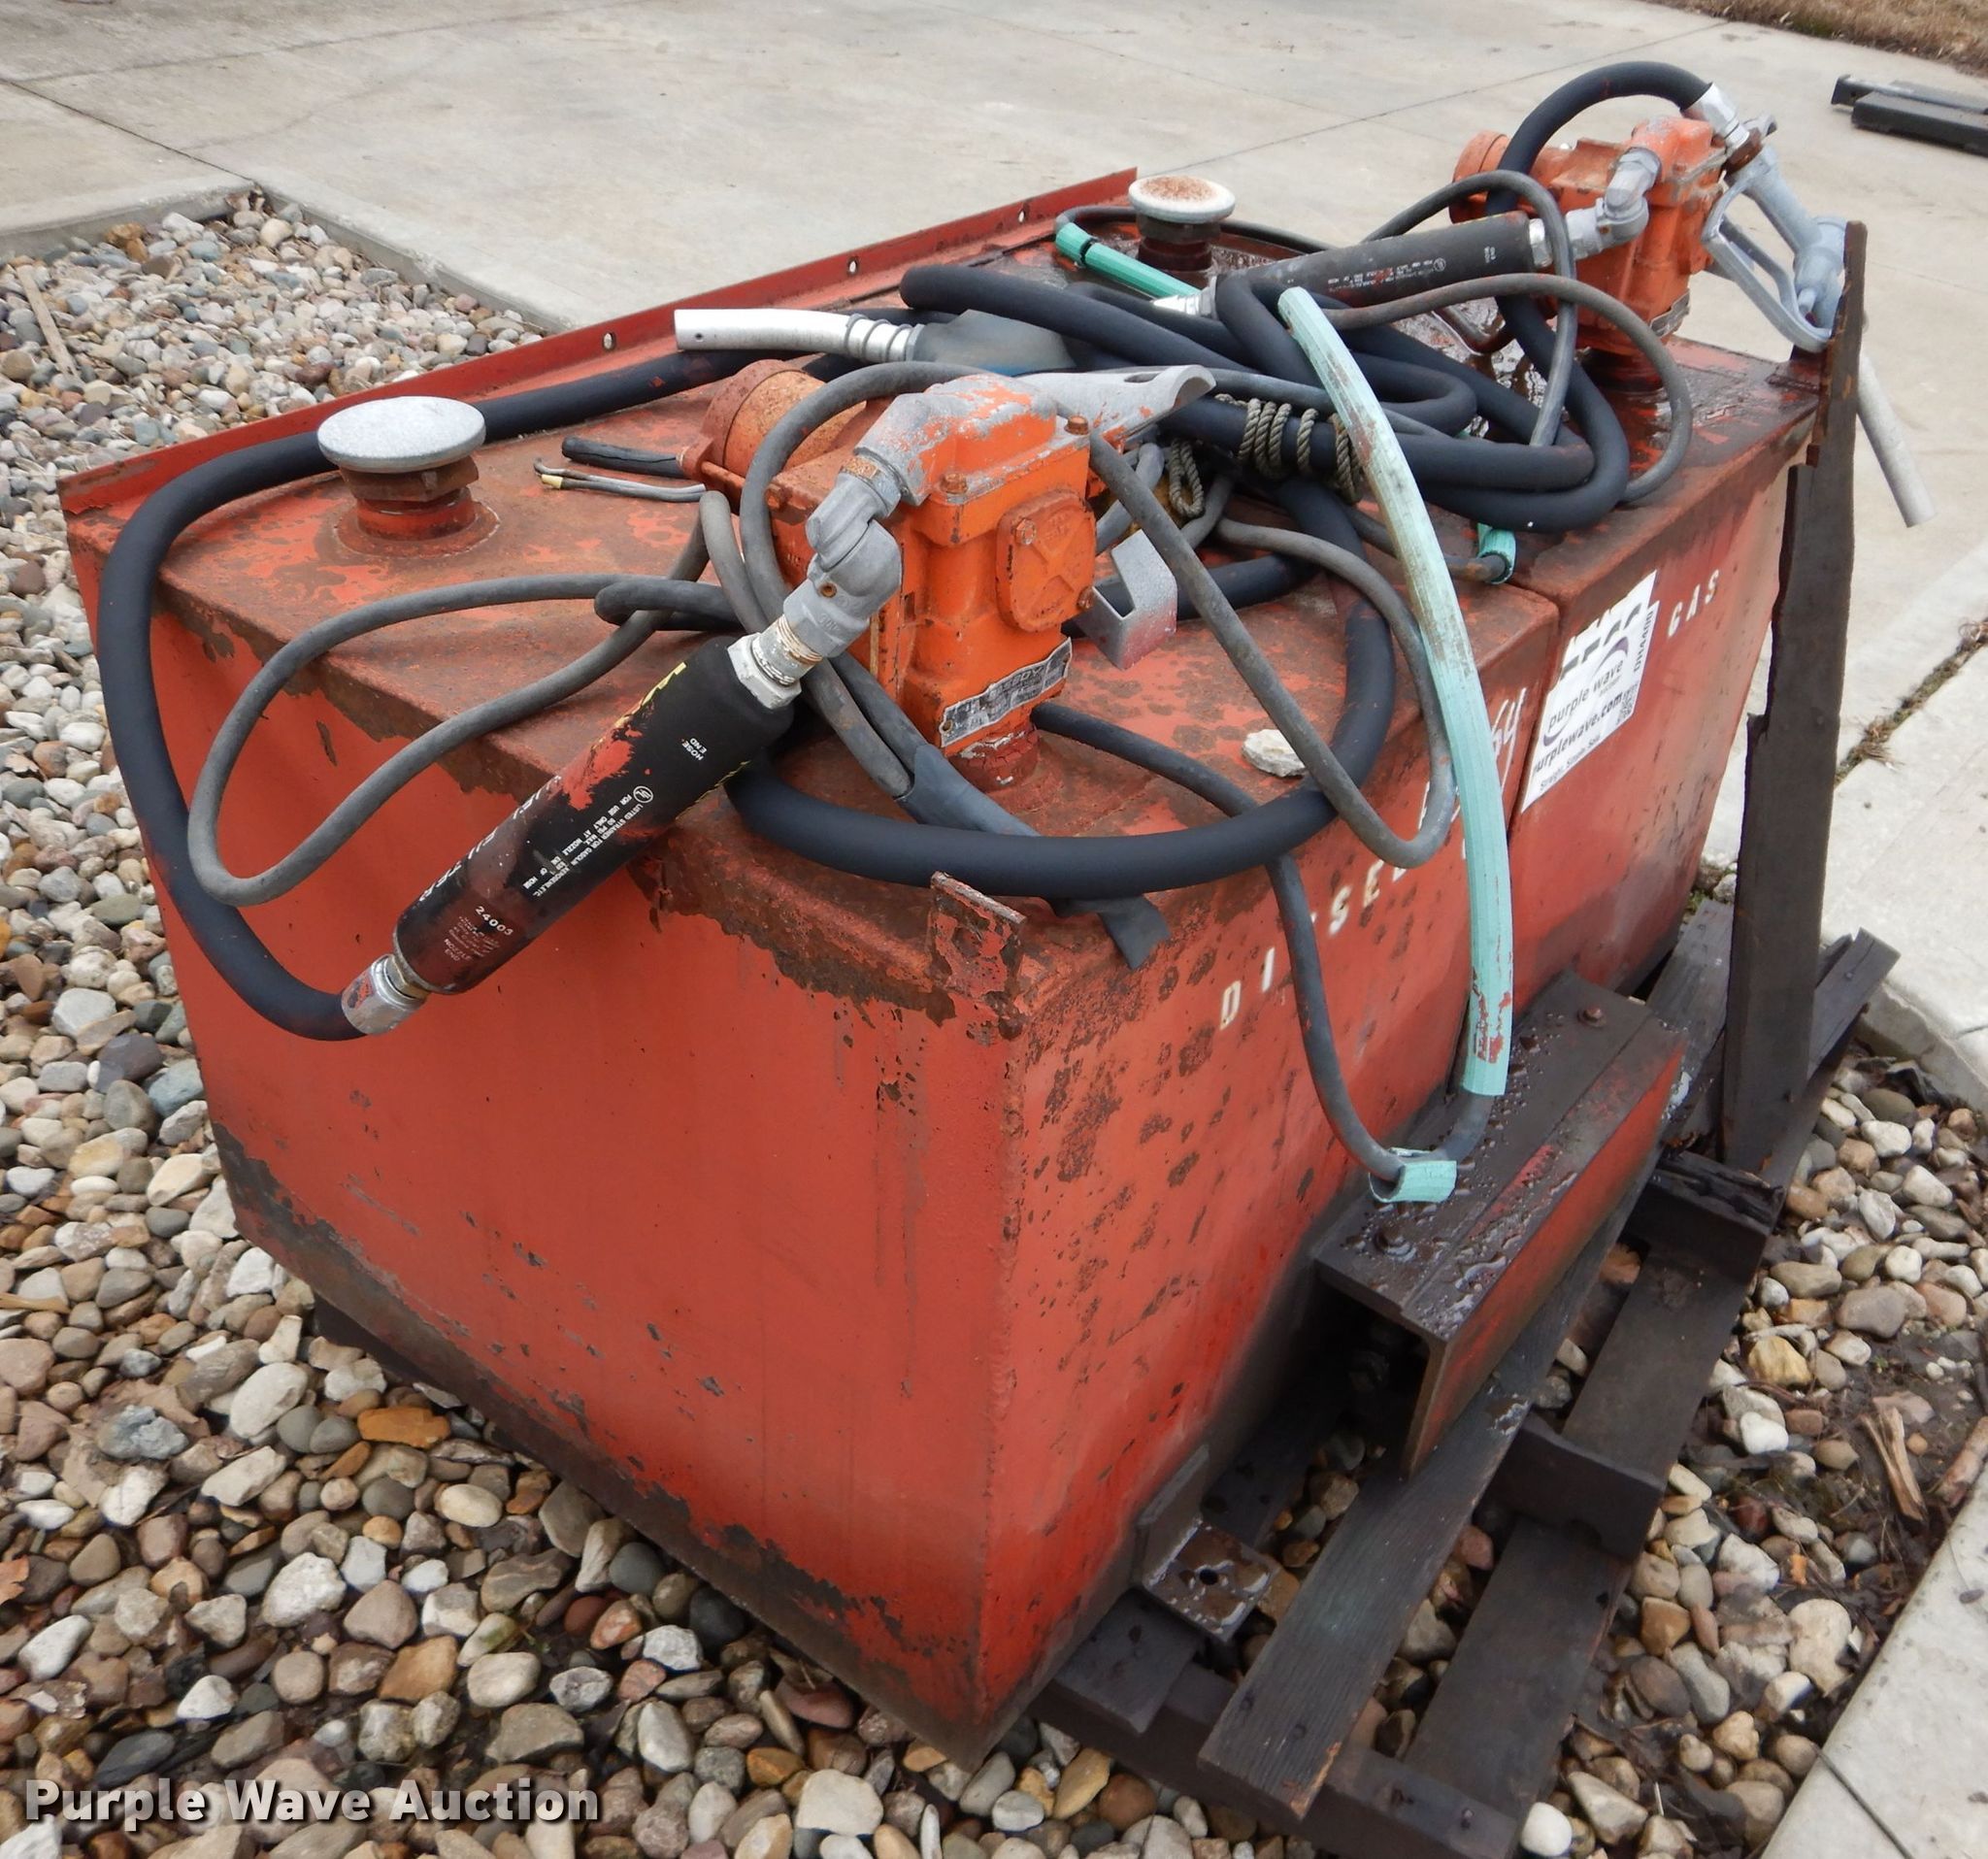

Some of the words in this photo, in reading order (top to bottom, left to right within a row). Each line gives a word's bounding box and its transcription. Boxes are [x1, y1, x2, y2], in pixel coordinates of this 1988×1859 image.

[1668, 570, 1719, 638] GAS
[1546, 685, 1590, 733] purple
[1593, 659, 1624, 694] wave
[680, 740, 704, 761] HOSE
[688, 737, 708, 754] END
[619, 793, 632, 805] FOR
[608, 804, 619, 815] USE
[623, 802, 643, 820] LISTED
[592, 814, 607, 829] ONLY
[582, 828, 591, 838] AT
[561, 837, 582, 855] NOZZLE
[589, 837, 602, 849] FOR
[569, 846, 592, 867] GASOLIN
[538, 866, 547, 876] OF
[522, 875, 538, 889] HOSE
[475, 905, 514, 936] 24003
[444, 938, 472, 961] NOZZLE
[1219, 859, 1408, 1031] DISE
[444, 947, 461, 962] END
